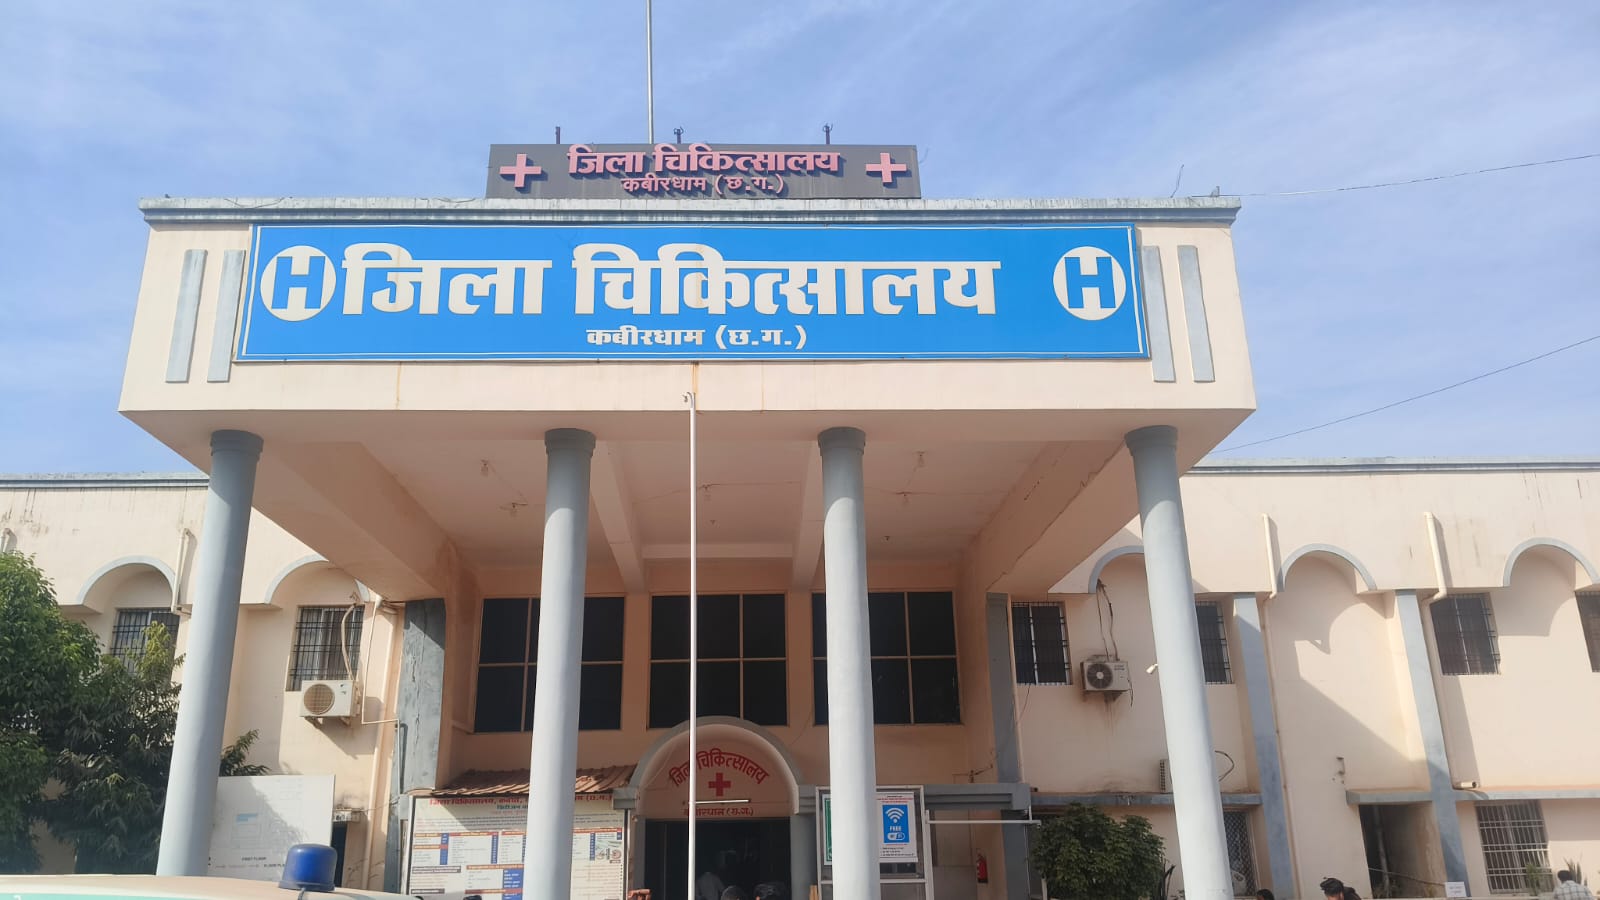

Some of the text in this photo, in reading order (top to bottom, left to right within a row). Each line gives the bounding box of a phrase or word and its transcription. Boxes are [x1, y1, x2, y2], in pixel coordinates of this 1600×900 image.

[567, 143, 841, 175] जिला चिकित्सालय
[621, 176, 706, 194] कबीरधाम
[342, 242, 1001, 315] जिला चिकित्सालय
[586, 325, 705, 346] कबीरधाम
[696, 748, 770, 785] चिकित्सालय
